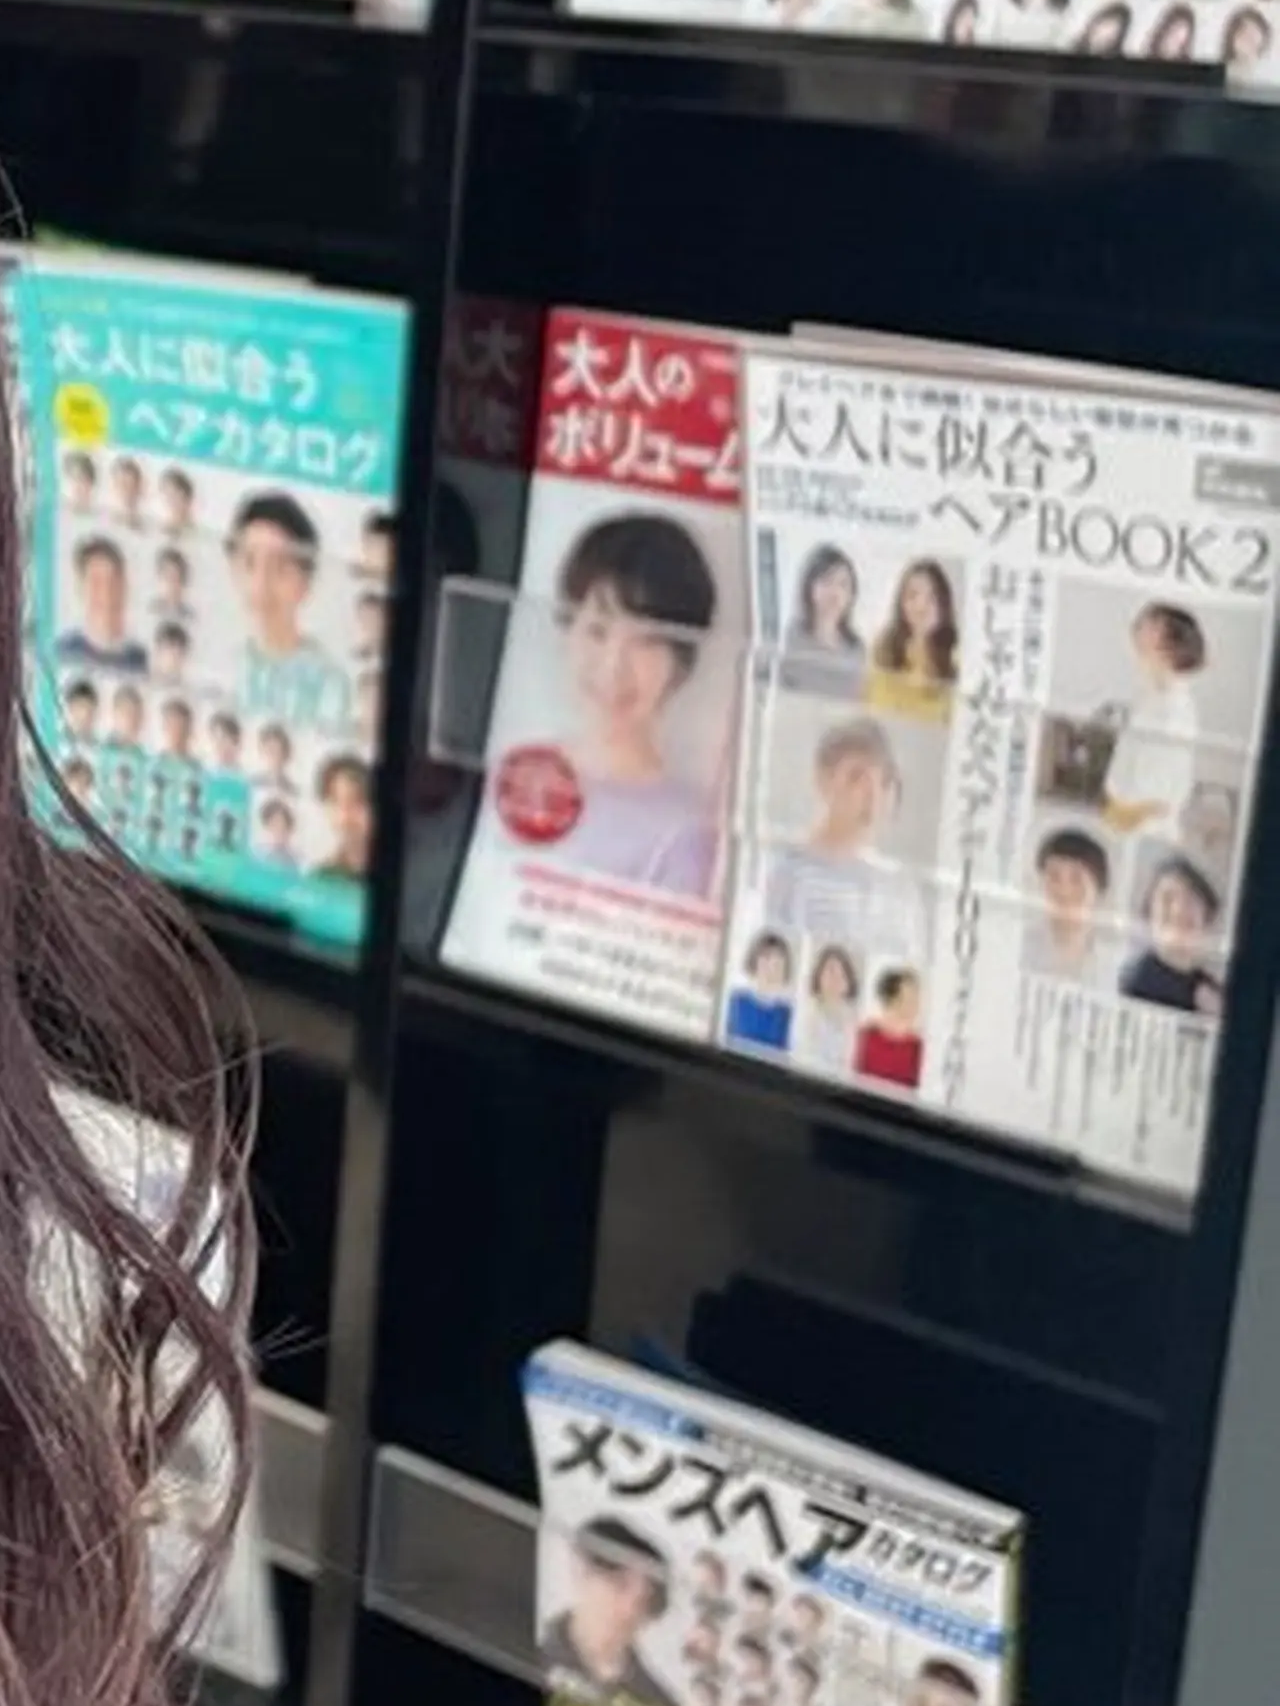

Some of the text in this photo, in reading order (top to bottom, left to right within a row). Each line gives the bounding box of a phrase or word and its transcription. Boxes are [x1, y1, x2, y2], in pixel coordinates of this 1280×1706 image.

[50, 321, 318, 411] 大人に似合う
[549, 323, 697, 406] 大人の
[126, 398, 382, 483] ヘアカタログ
[758, 391, 1100, 494] 大人に似合う
[867, 1519, 995, 1595] カタログ
